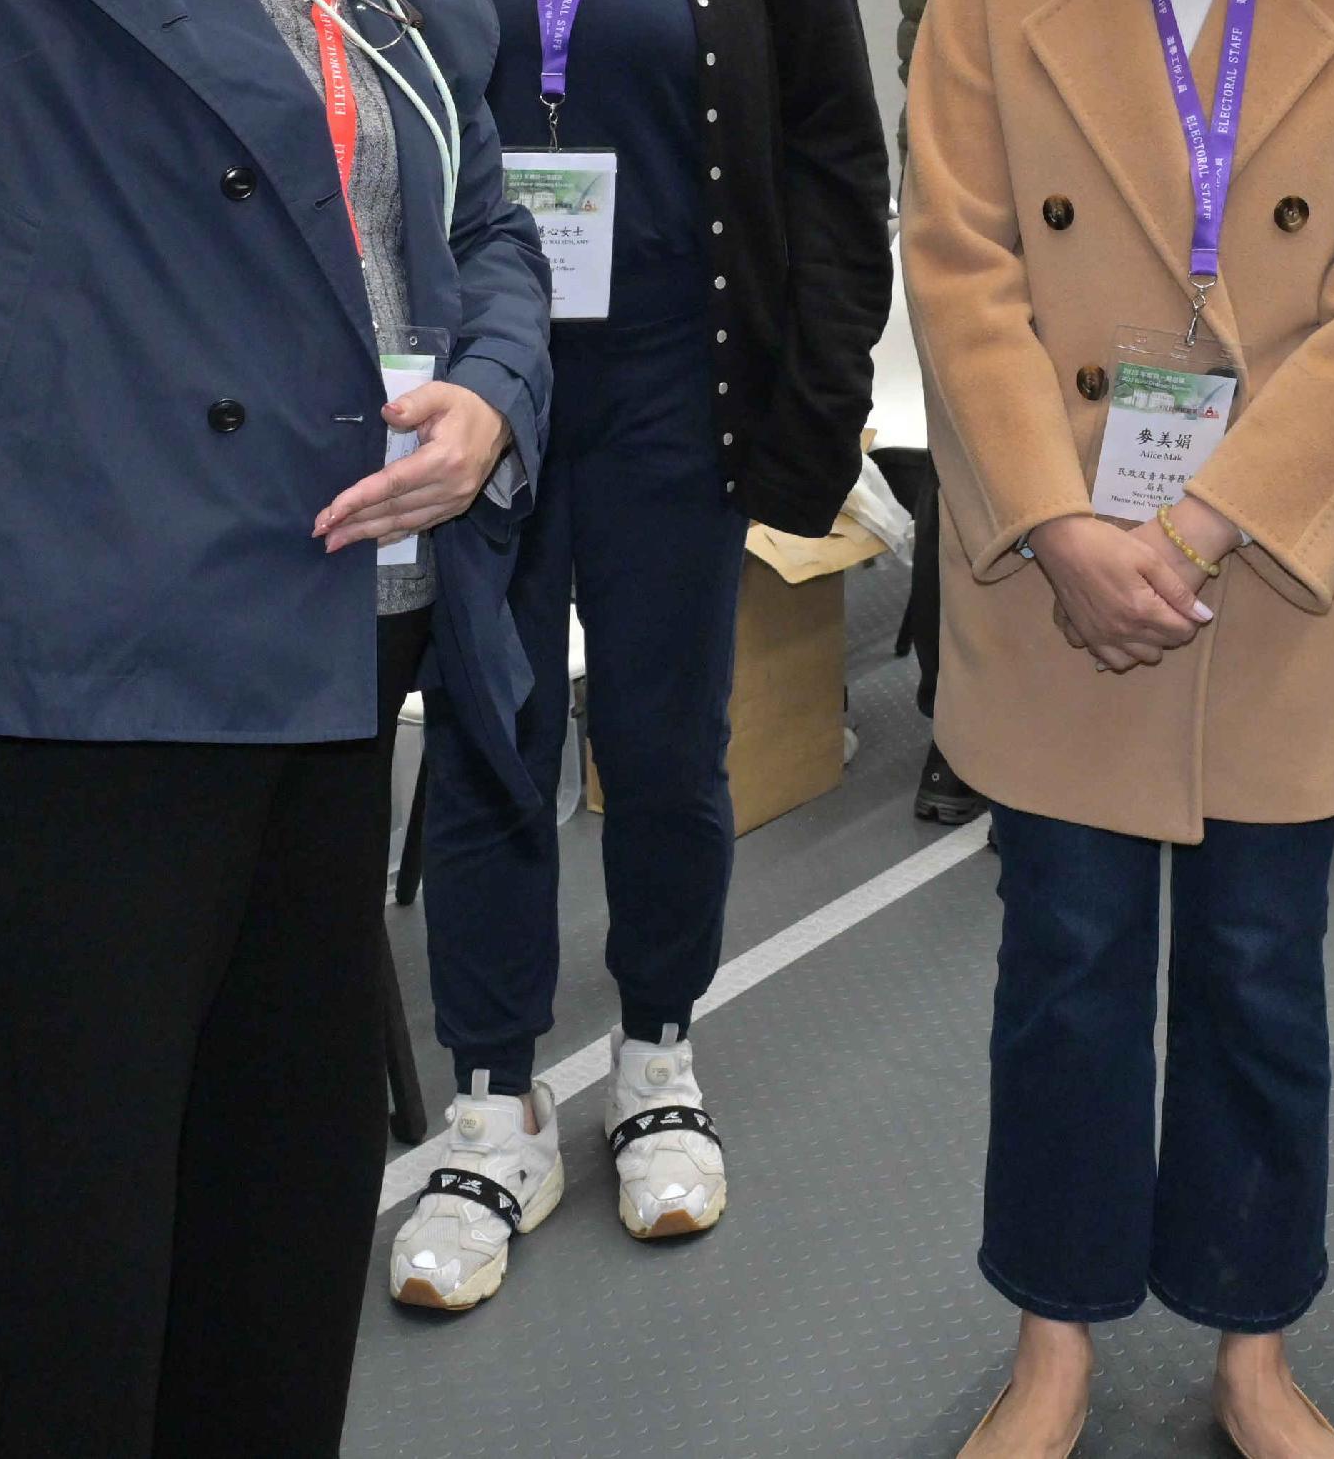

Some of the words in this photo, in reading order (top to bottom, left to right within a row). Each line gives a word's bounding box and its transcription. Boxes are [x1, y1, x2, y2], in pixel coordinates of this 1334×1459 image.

[552, 19, 566, 51] STAFF
[327, 45, 347, 116] ELECTORAL
[1217, 67, 1238, 134] ELECTORAL
[1228, 26, 1243, 64] STAFF
[1186, 115, 1210, 179] ELECTORAL
[1200, 182, 1211, 220] STAFF
